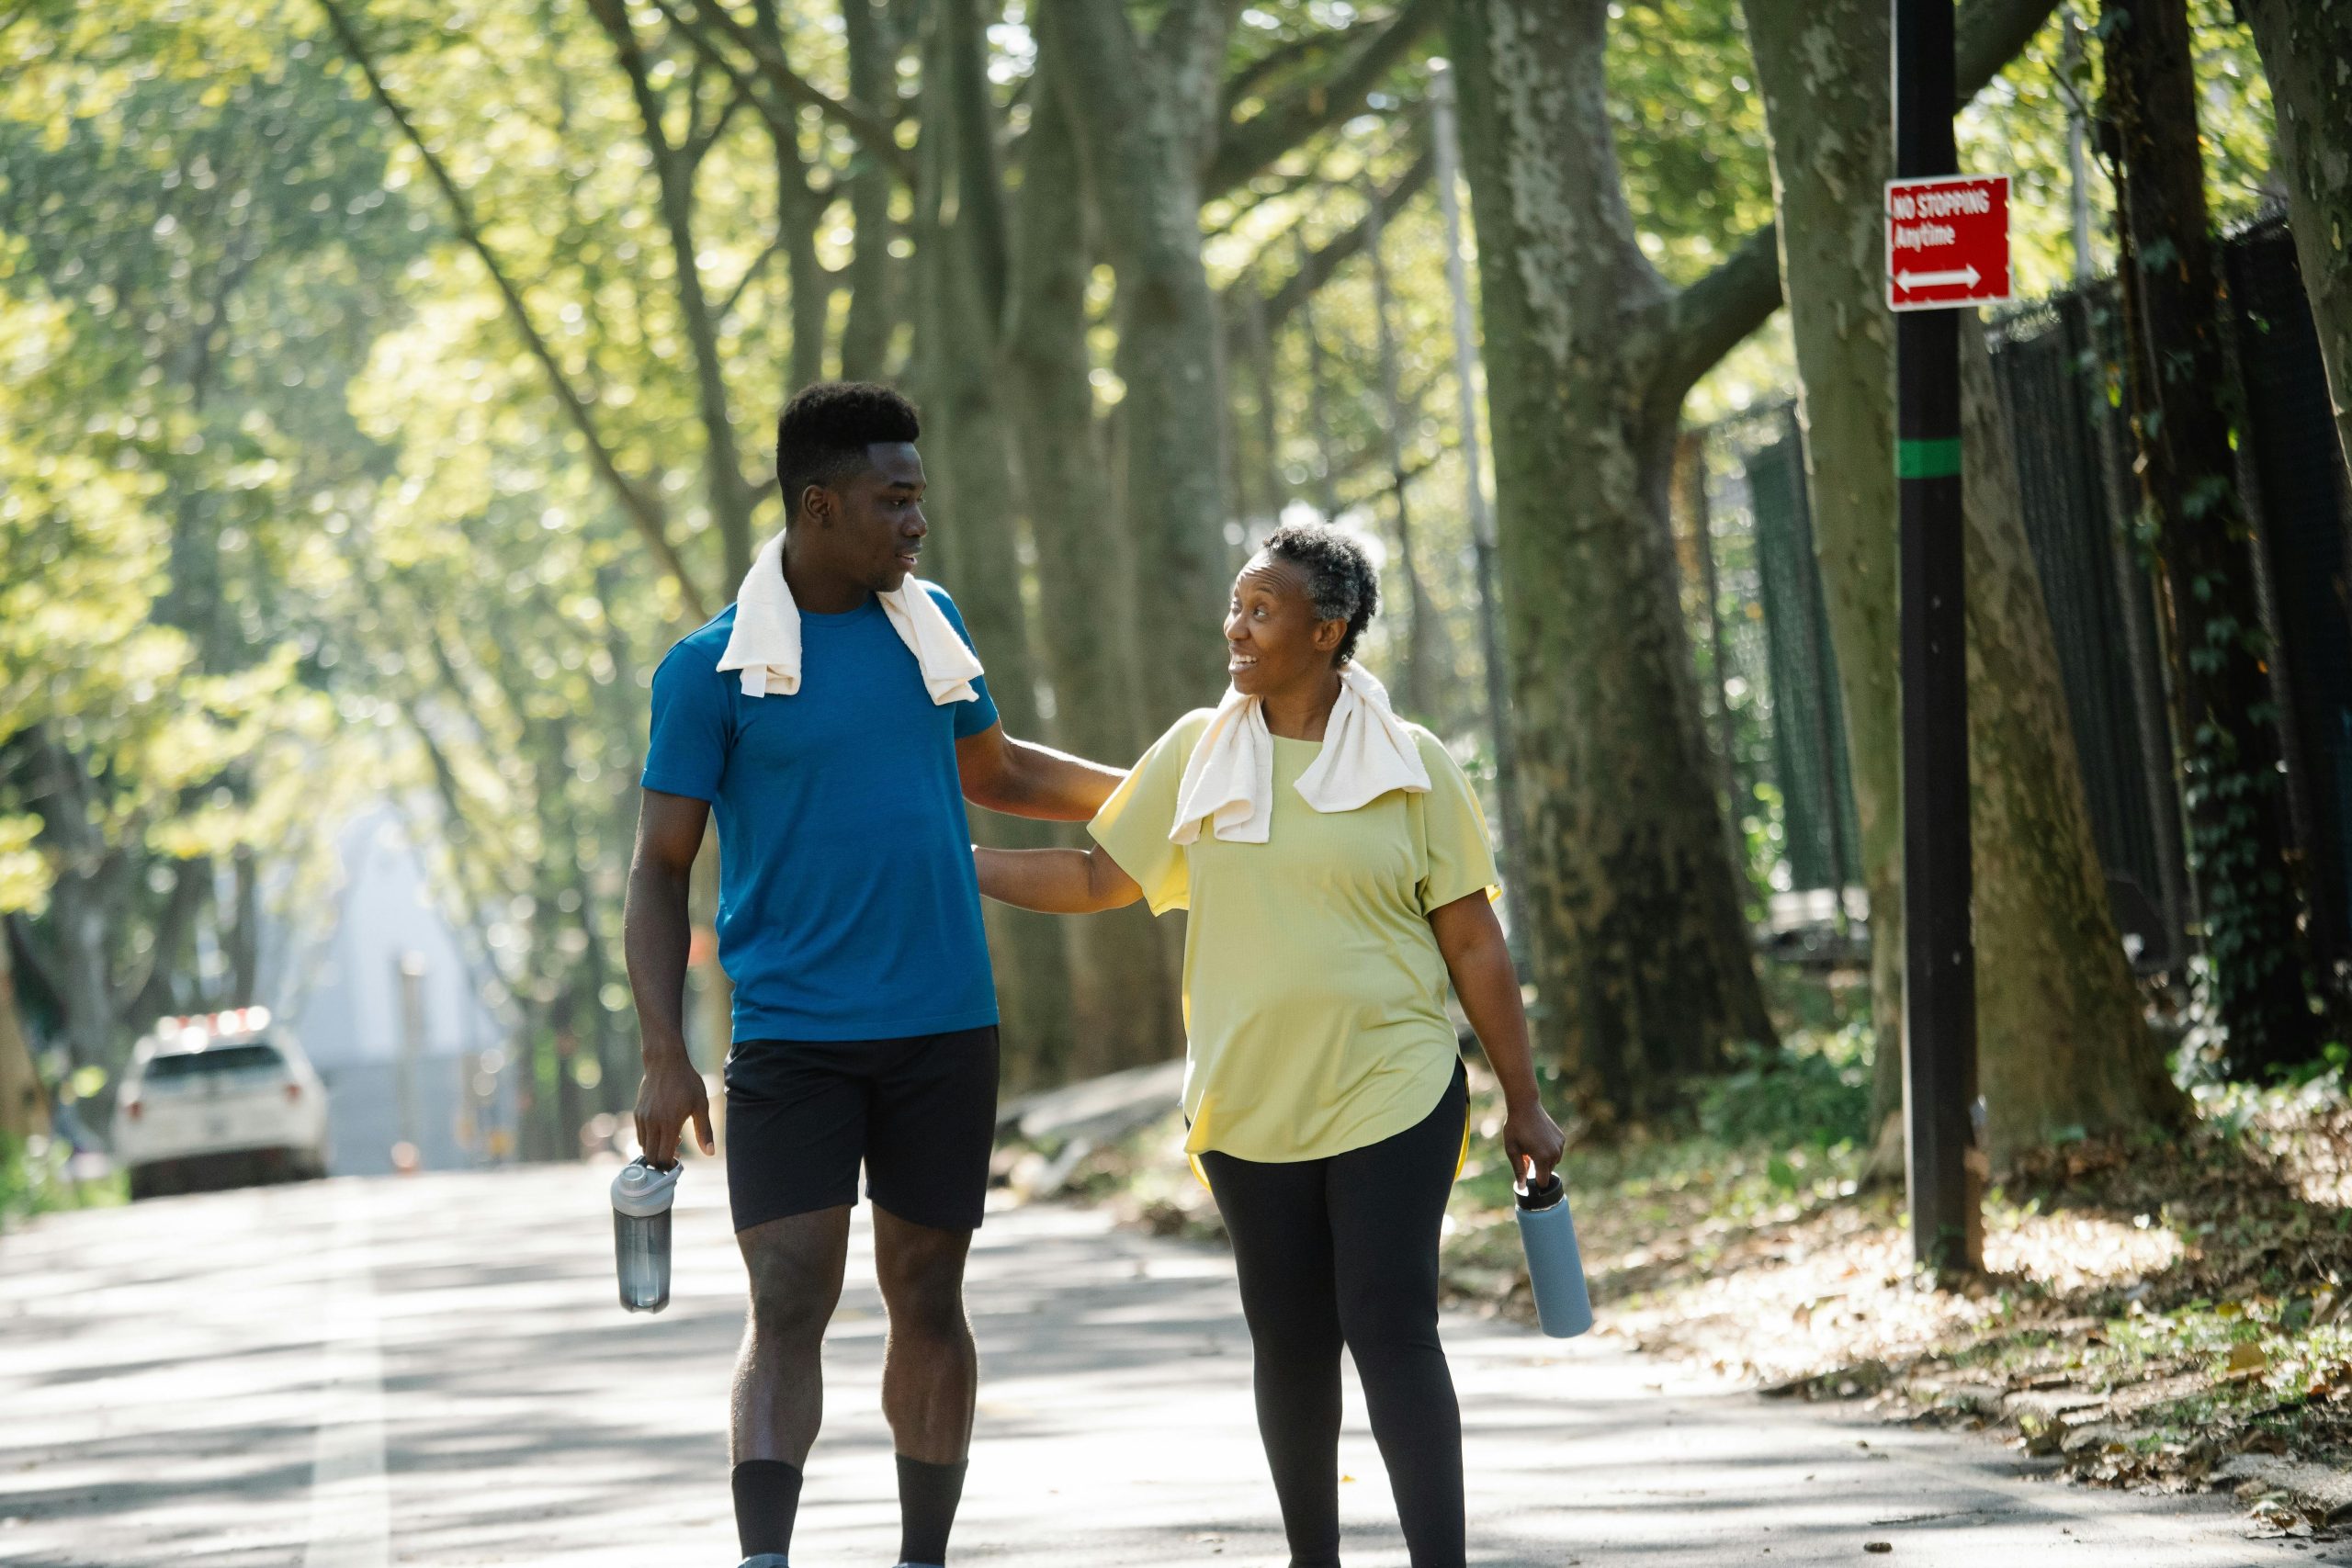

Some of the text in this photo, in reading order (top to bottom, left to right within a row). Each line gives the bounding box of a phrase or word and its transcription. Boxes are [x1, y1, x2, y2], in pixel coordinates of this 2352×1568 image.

[1893, 188, 1990, 220] NO STOPPING
[1894, 220, 1955, 253] Anytime
